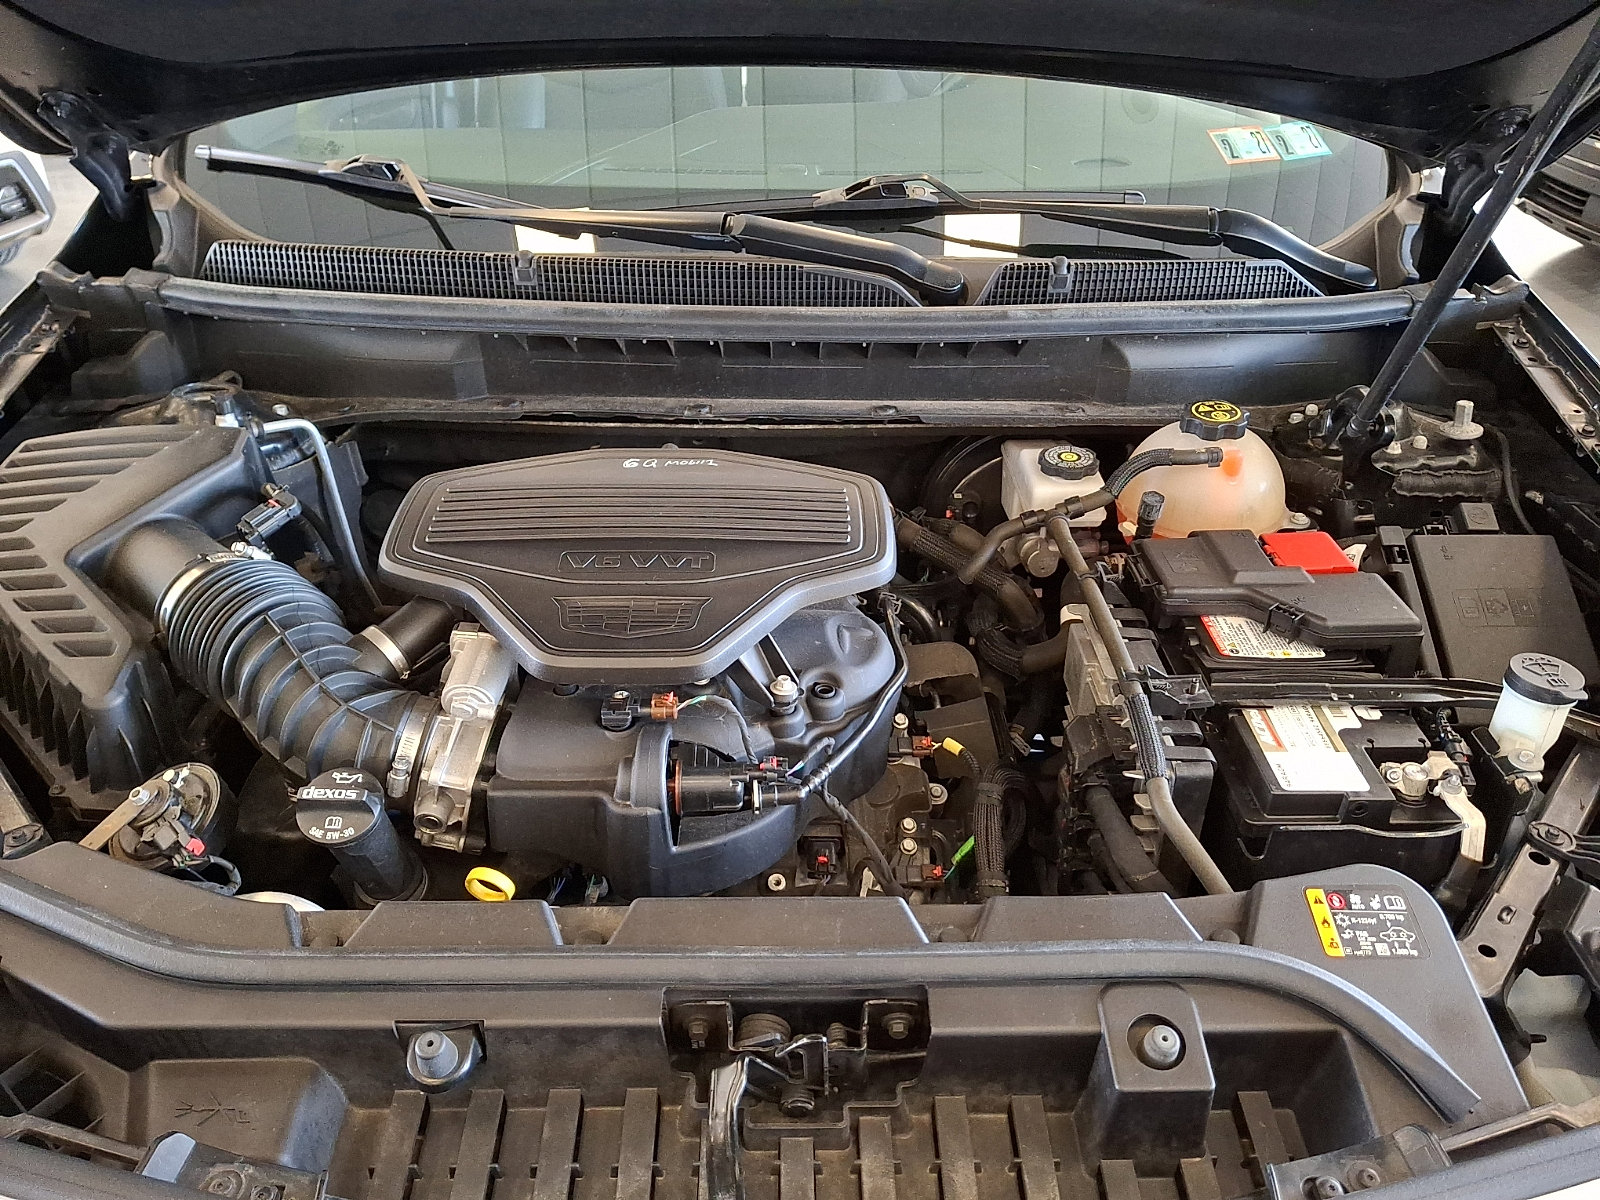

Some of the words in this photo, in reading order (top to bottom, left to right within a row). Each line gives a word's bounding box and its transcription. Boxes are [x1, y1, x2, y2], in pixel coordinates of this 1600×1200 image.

[1221, 139, 1239, 159] 2
[1276, 135, 1294, 155] 2
[566, 554, 621, 569] V6
[629, 554, 710, 569] VVT
[302, 786, 360, 799] dexos
[308, 826, 324, 839] SAE
[325, 827, 355, 840] 5W-30
